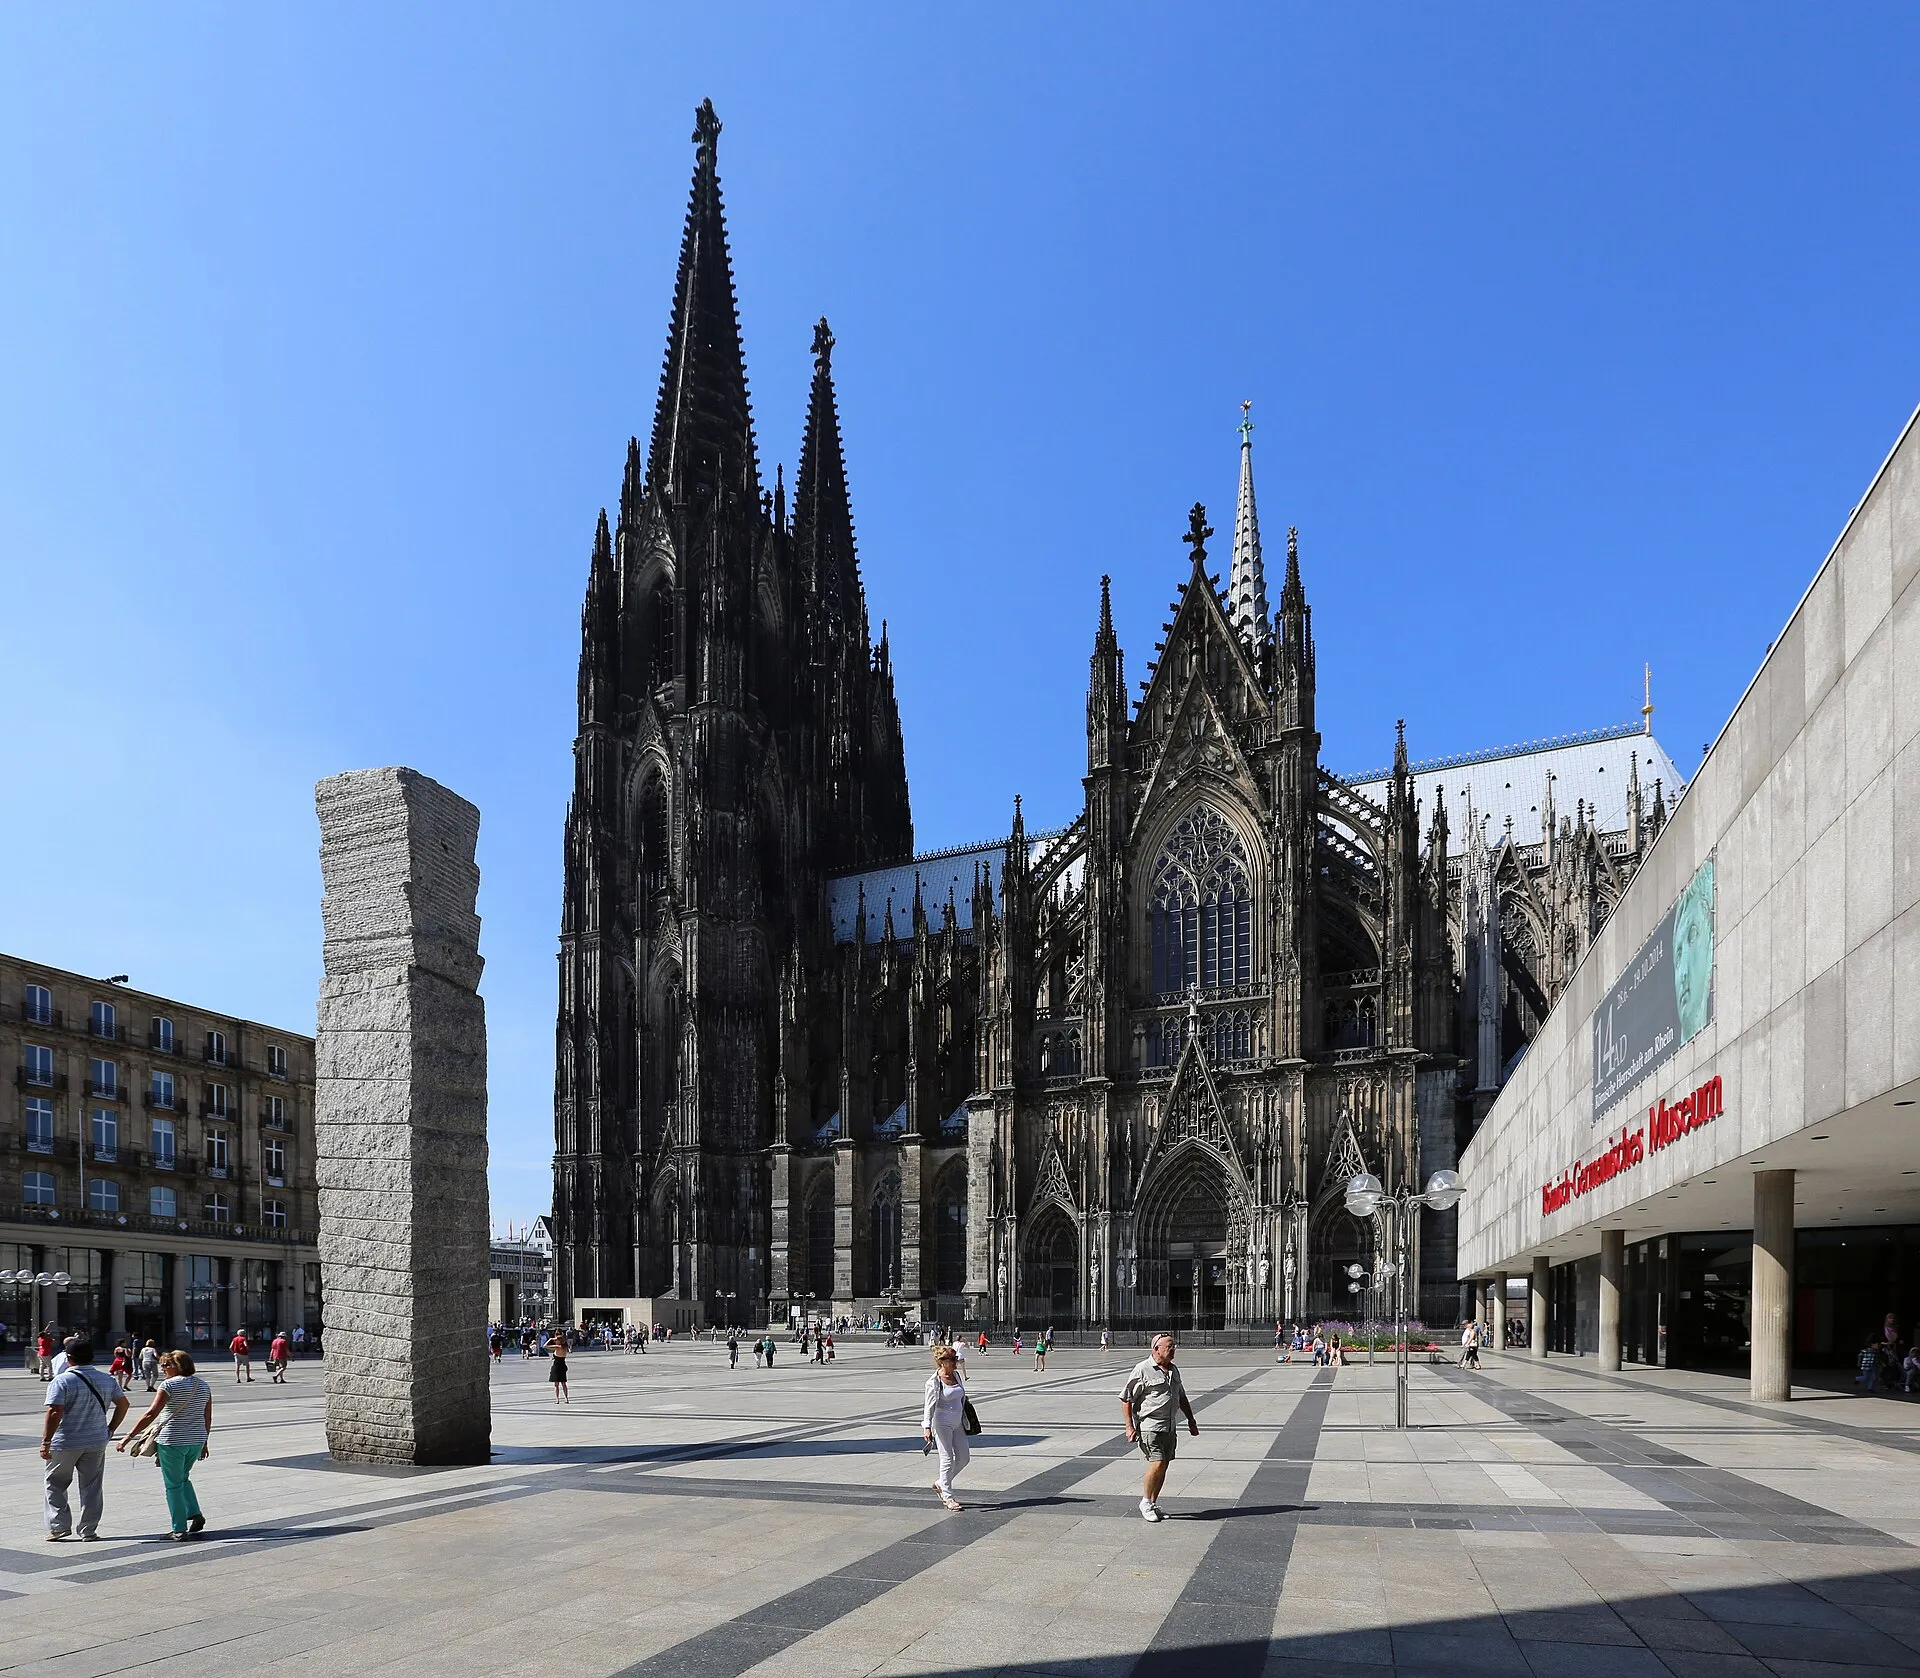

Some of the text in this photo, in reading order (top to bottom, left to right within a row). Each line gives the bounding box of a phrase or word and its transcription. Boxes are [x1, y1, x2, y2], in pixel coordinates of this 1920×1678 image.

[1616, 1051, 1643, 1090] Herrschaft
[1644, 1046, 1654, 1065] am
[1654, 1026, 1674, 1056] Rhein
[1648, 1075, 1724, 1157] Museum
